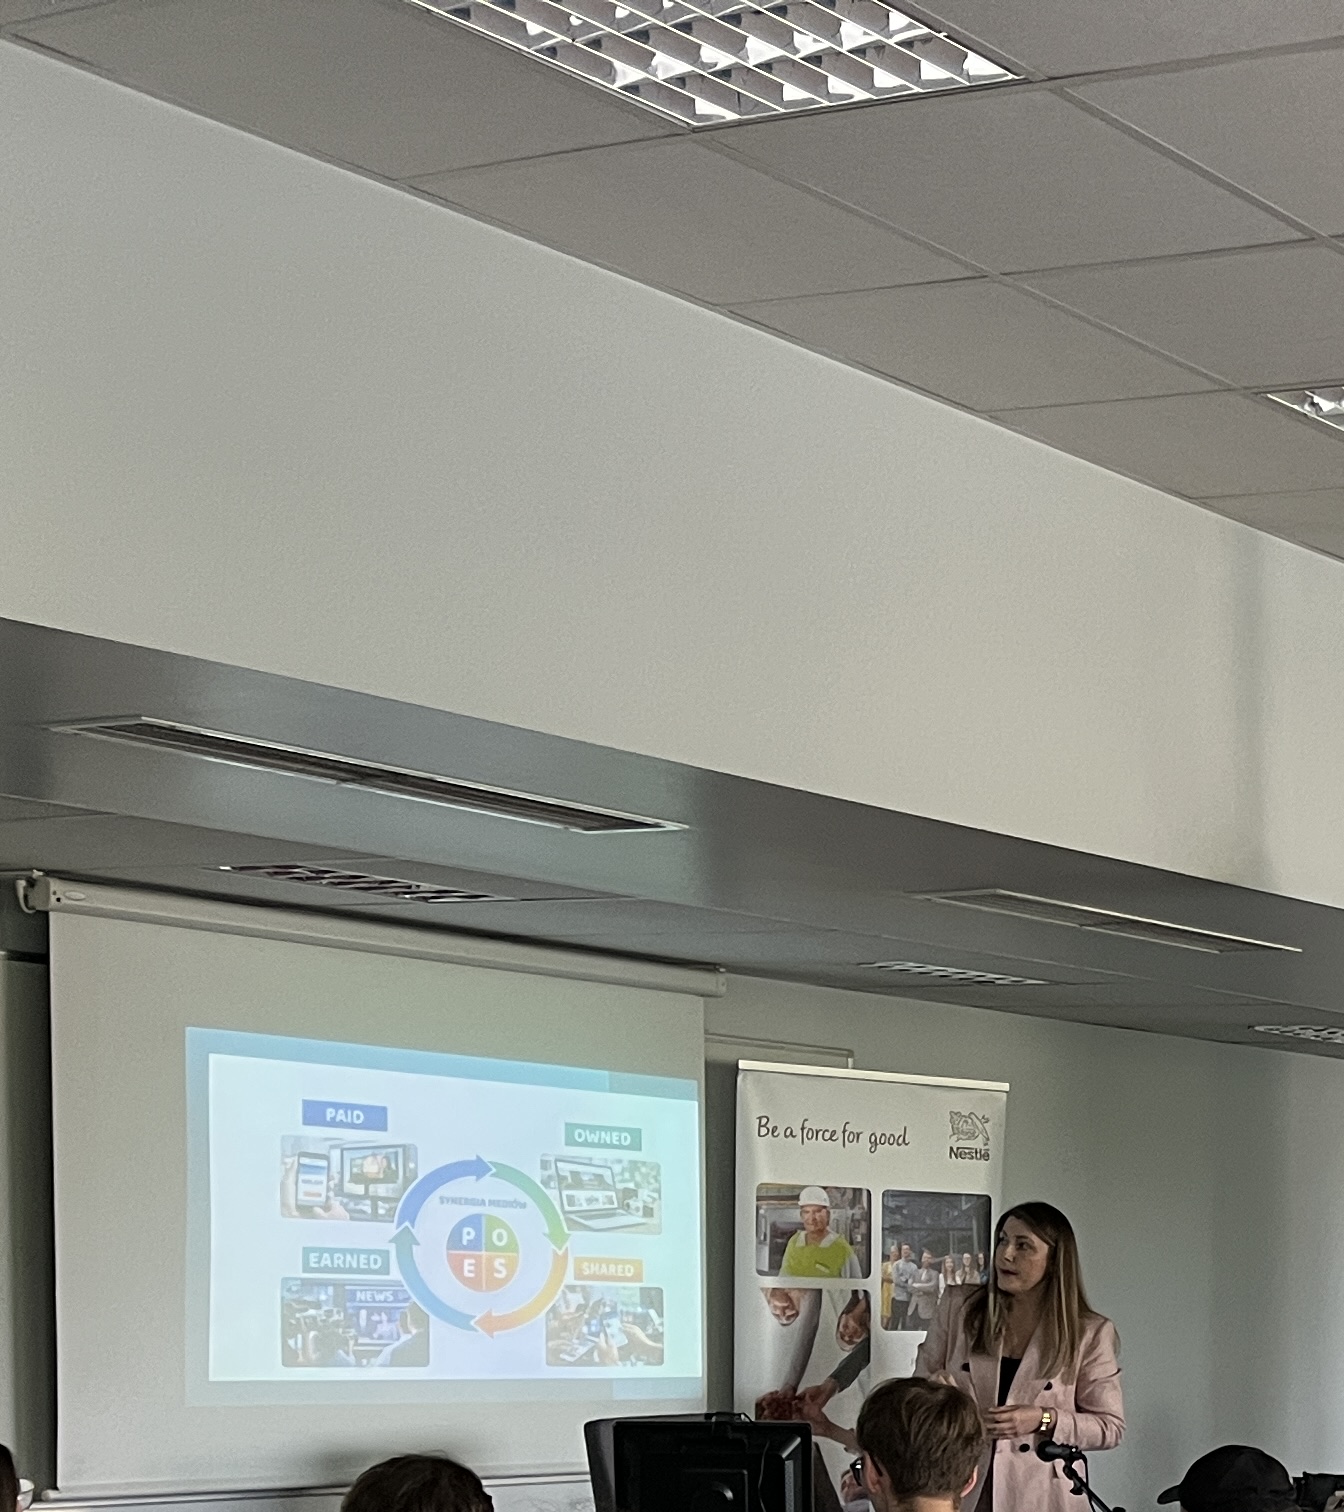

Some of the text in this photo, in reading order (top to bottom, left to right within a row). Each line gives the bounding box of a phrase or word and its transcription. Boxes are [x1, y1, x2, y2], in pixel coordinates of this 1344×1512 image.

[325, 1107, 365, 1125] PAID
[573, 1128, 632, 1146] OWNED
[756, 1115, 910, 1154] Be a force for good
[462, 1226, 508, 1247] P O
[308, 1252, 383, 1270] EARNED
[463, 1257, 507, 1279] E S
[580, 1261, 635, 1278] SHARED
[355, 1290, 395, 1303] NEWS
